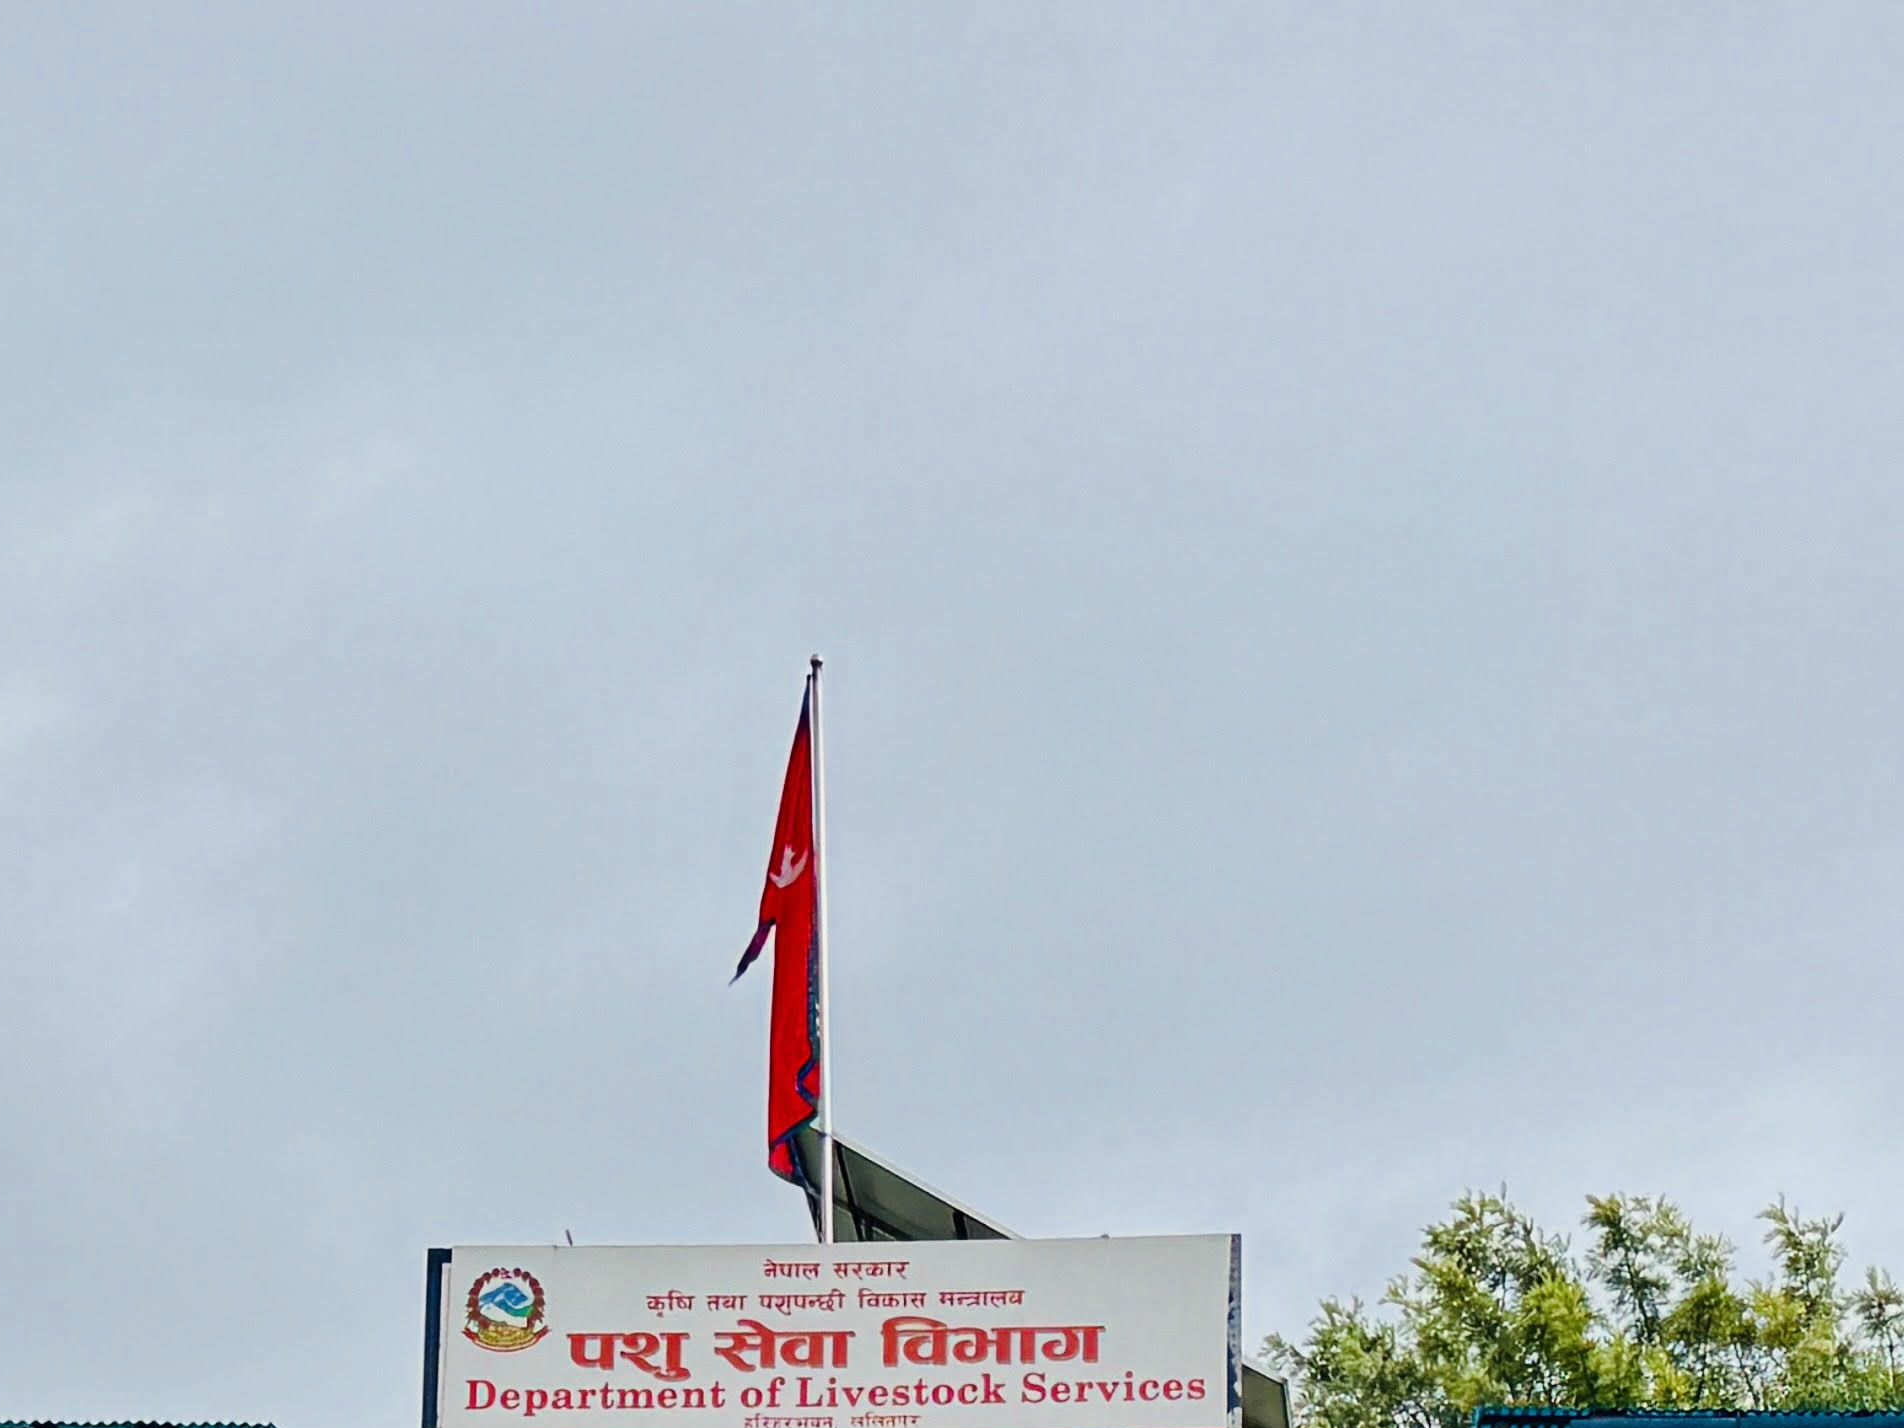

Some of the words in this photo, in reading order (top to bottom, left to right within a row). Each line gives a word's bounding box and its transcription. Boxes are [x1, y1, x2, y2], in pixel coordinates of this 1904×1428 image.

[763, 1259, 820, 1278] नेपाल
[834, 1261, 909, 1280] सरकार
[647, 1290, 694, 1317] कृषि
[707, 1294, 748, 1311] तथा
[859, 1289, 926, 1310] विकास
[567, 1331, 691, 1382] पशु
[714, 1319, 856, 1372] सेवा
[881, 1316, 1106, 1367] विभाग
[465, 1379, 725, 1417] Department
[741, 1377, 786, 1408] of
[795, 1373, 1006, 1409] Livestock
[1021, 1371, 1207, 1405] Services
